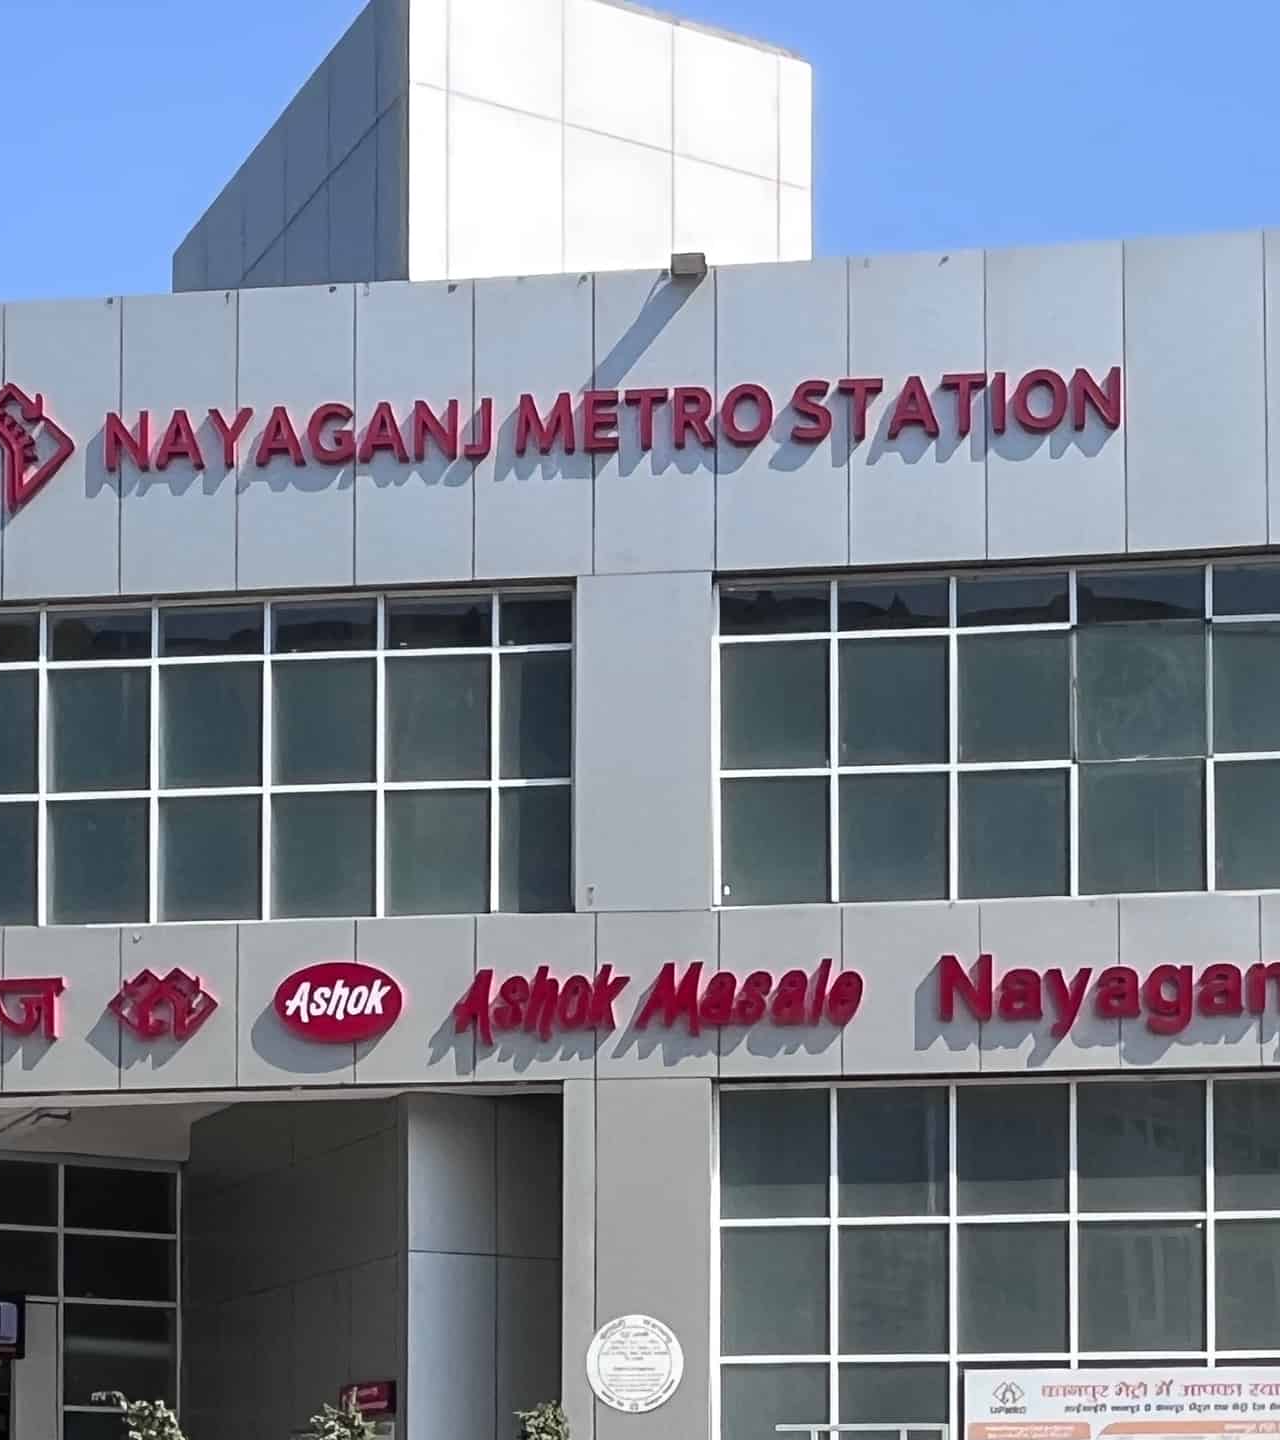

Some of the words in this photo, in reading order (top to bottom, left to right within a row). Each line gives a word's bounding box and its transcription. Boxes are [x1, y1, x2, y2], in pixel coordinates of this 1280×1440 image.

[104, 397, 493, 473] NAYAGANJ
[514, 382, 774, 456] METRO
[789, 365, 1122, 443] STATION
[285, 979, 391, 1023] Ashok
[455, 962, 628, 1035] Ashok
[635, 958, 864, 1032] Masale
